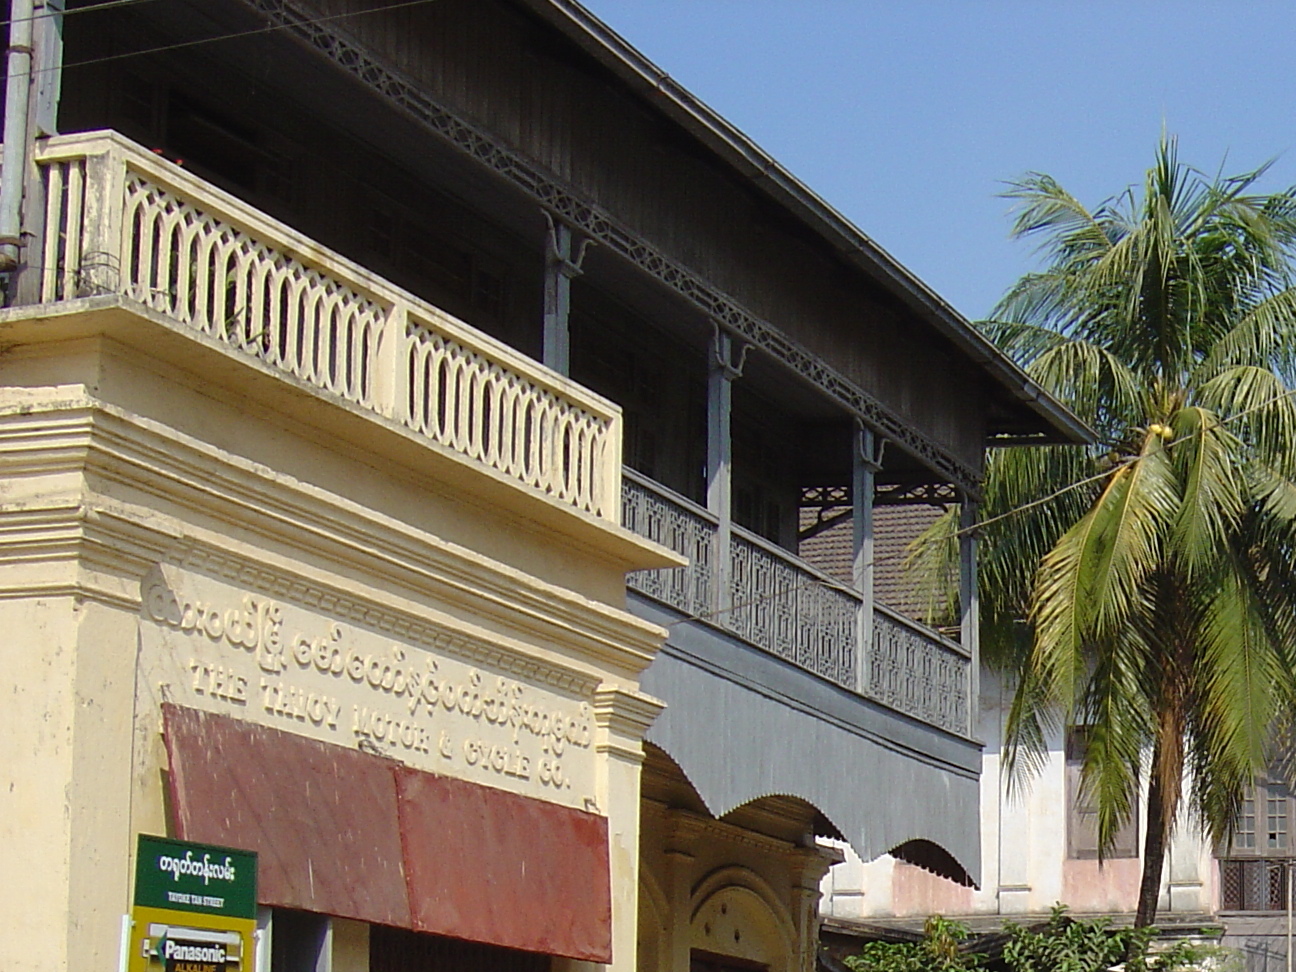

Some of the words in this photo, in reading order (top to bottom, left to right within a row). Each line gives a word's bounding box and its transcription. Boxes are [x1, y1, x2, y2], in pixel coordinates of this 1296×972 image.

[190, 658, 247, 705] THE
[260, 677, 341, 730] TAVOY
[354, 704, 430, 753] MOTOR
[439, 729, 453, 759] &
[464, 738, 530, 780] CYCLE
[165, 939, 225, 963] Panasonic
